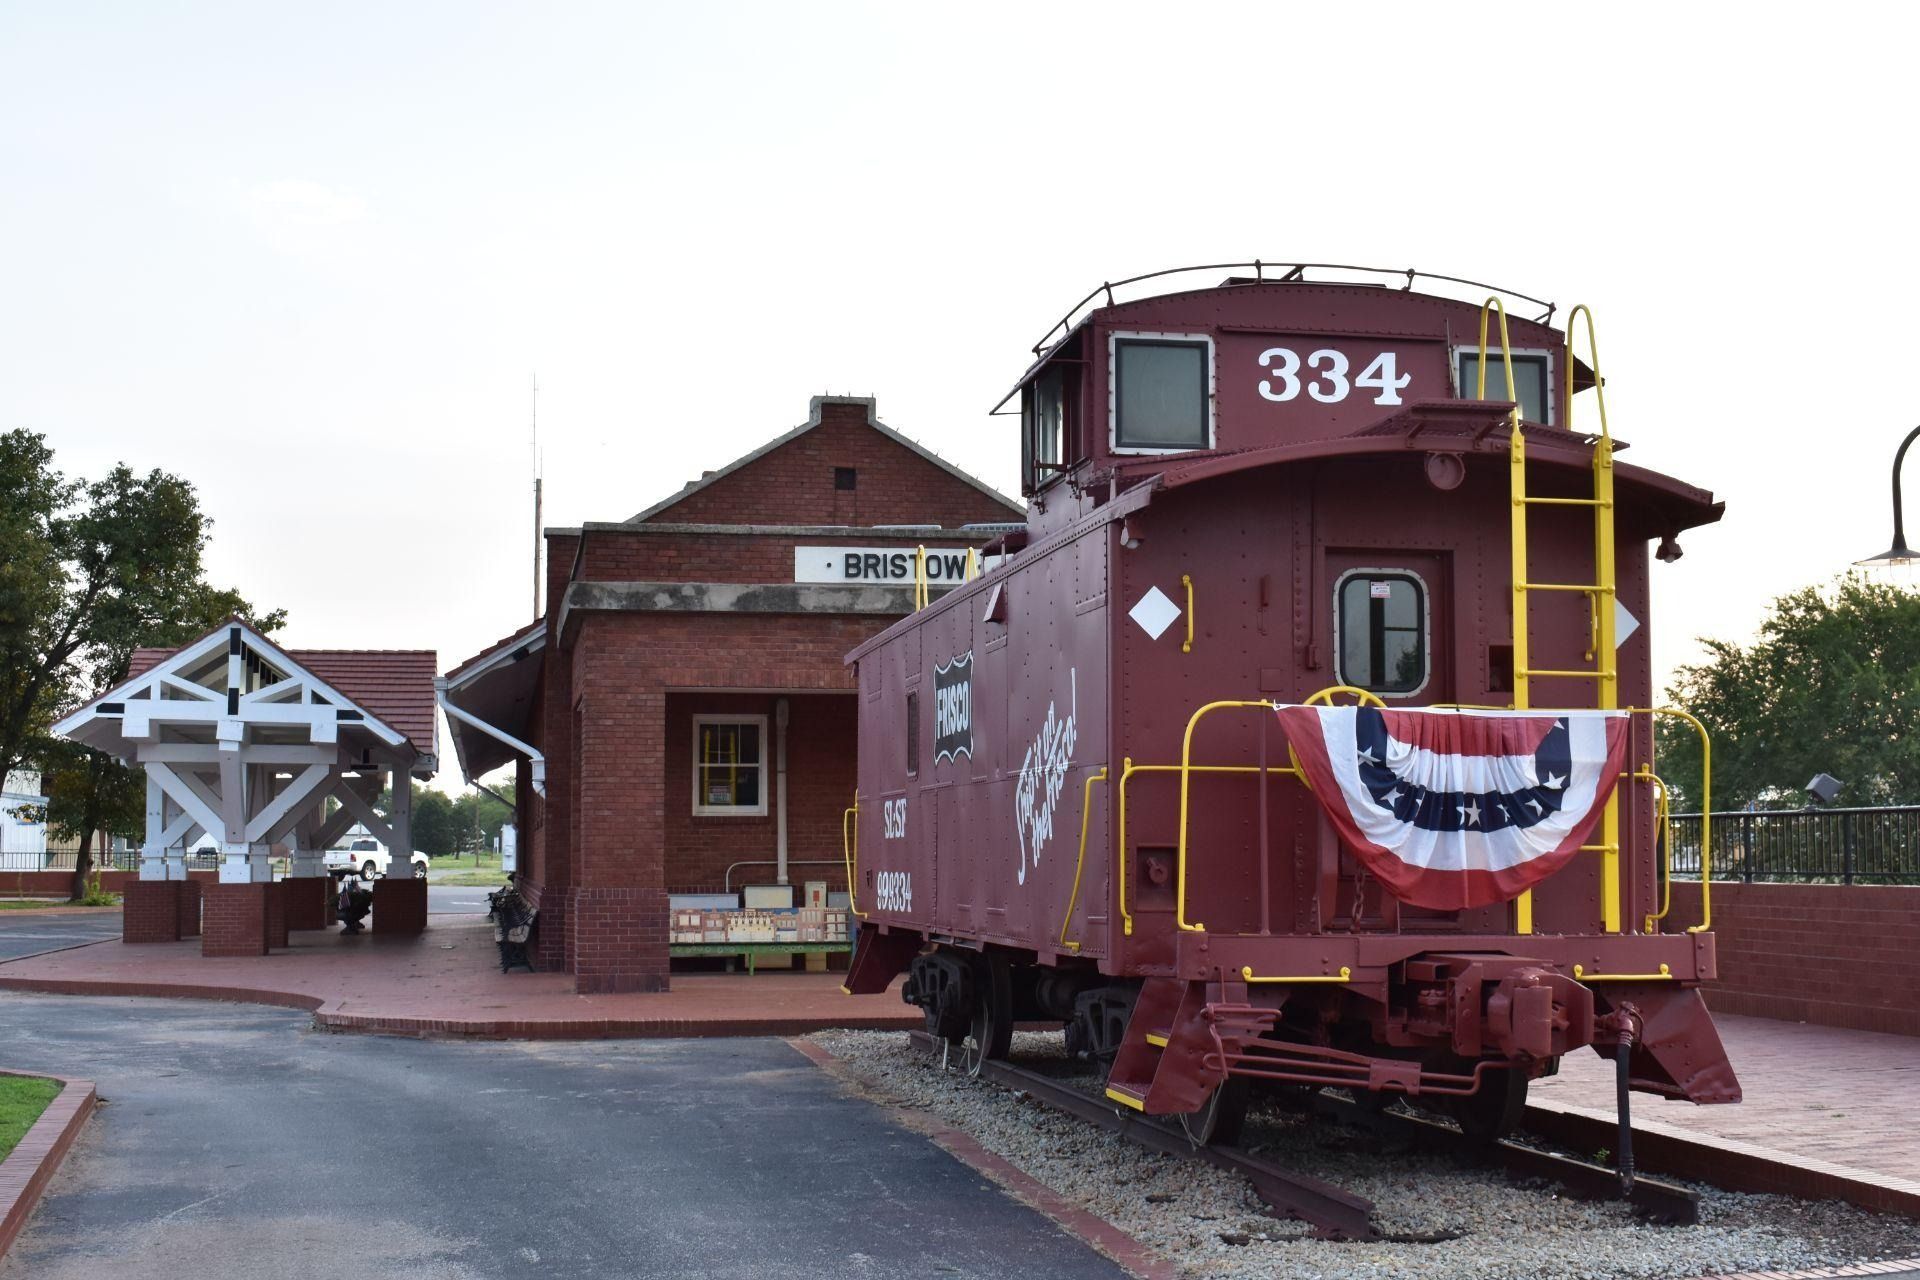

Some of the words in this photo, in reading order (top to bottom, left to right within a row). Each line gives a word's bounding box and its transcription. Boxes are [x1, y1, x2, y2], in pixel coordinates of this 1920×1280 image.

[1258, 347, 1412, 406] 334
[844, 552, 967, 581] BRISTOW
[936, 680, 969, 740] FRISCO
[1015, 746, 1036, 886] Ship
[1033, 733, 1043, 789] it
[1042, 700, 1056, 760] on
[1032, 801, 1049, 868] the
[877, 870, 912, 913] 999334
